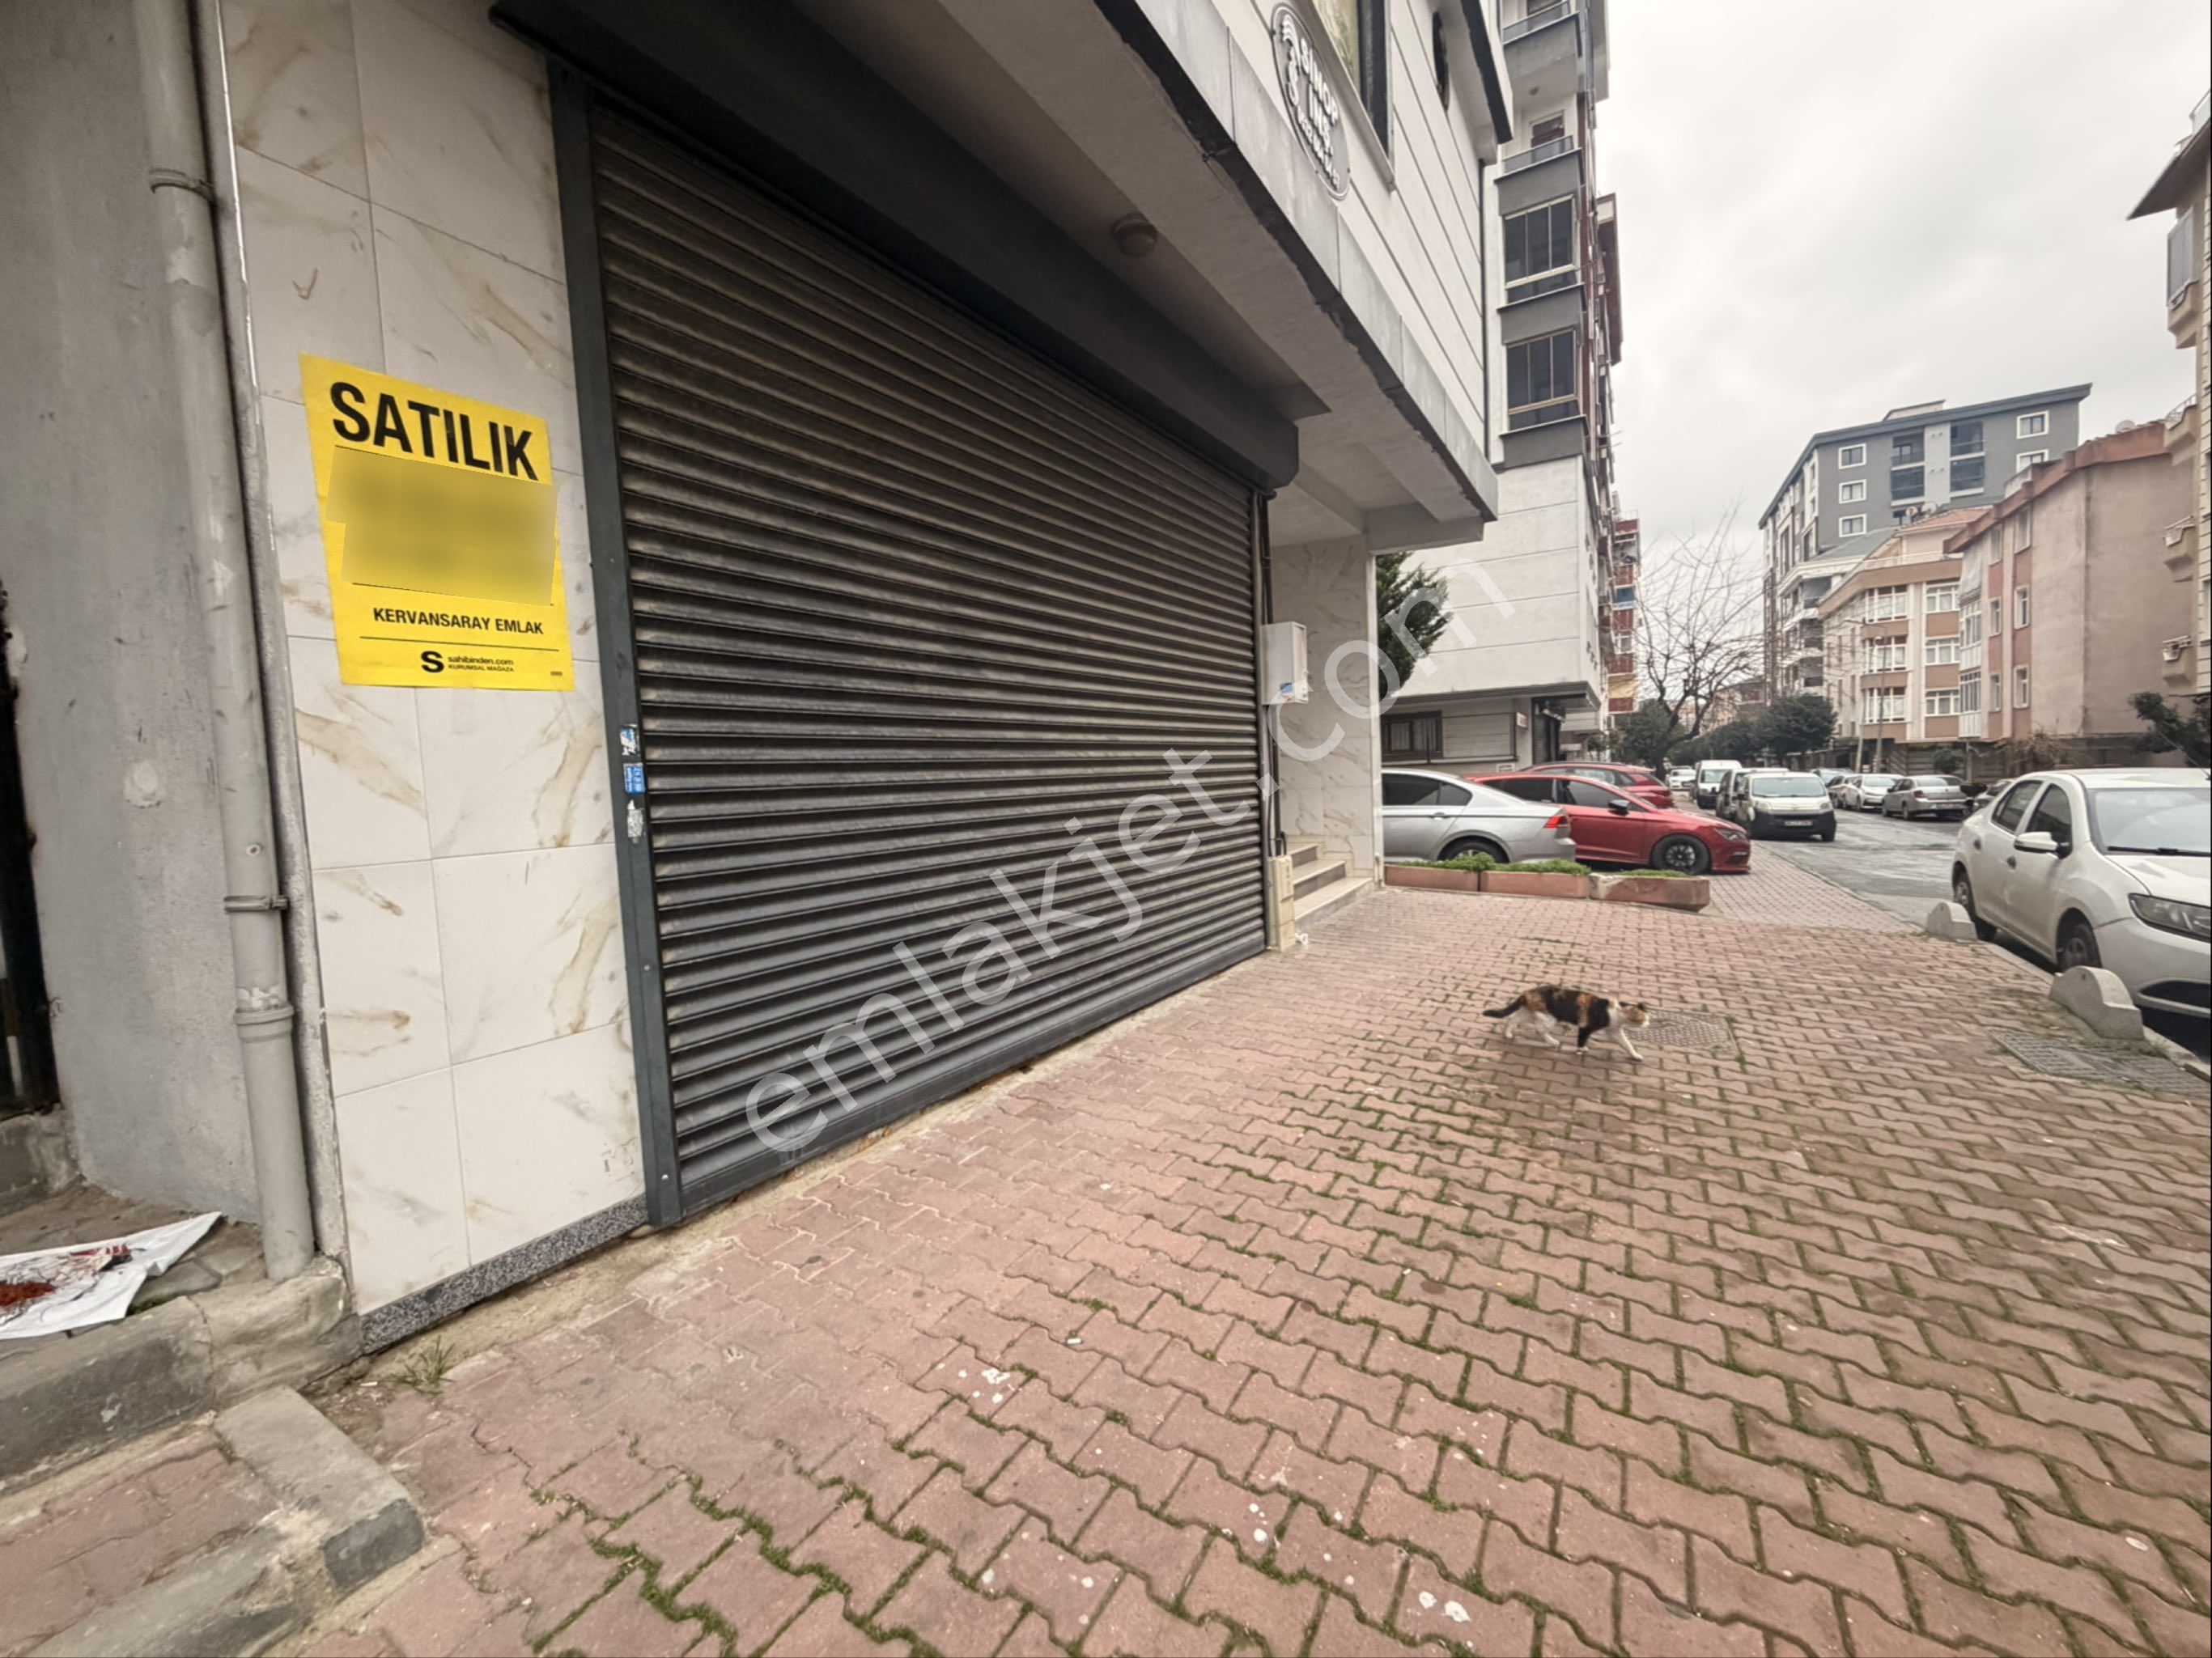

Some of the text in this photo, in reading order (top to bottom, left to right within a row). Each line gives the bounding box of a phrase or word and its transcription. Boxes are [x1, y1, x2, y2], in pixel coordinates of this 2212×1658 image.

[330, 382, 538, 481] SATILIK
[373, 608, 544, 635] KERVANSARAY EMLAK
[448, 655, 514, 666] sahibinden.com
[448, 664, 486, 672] KURUMSAL
